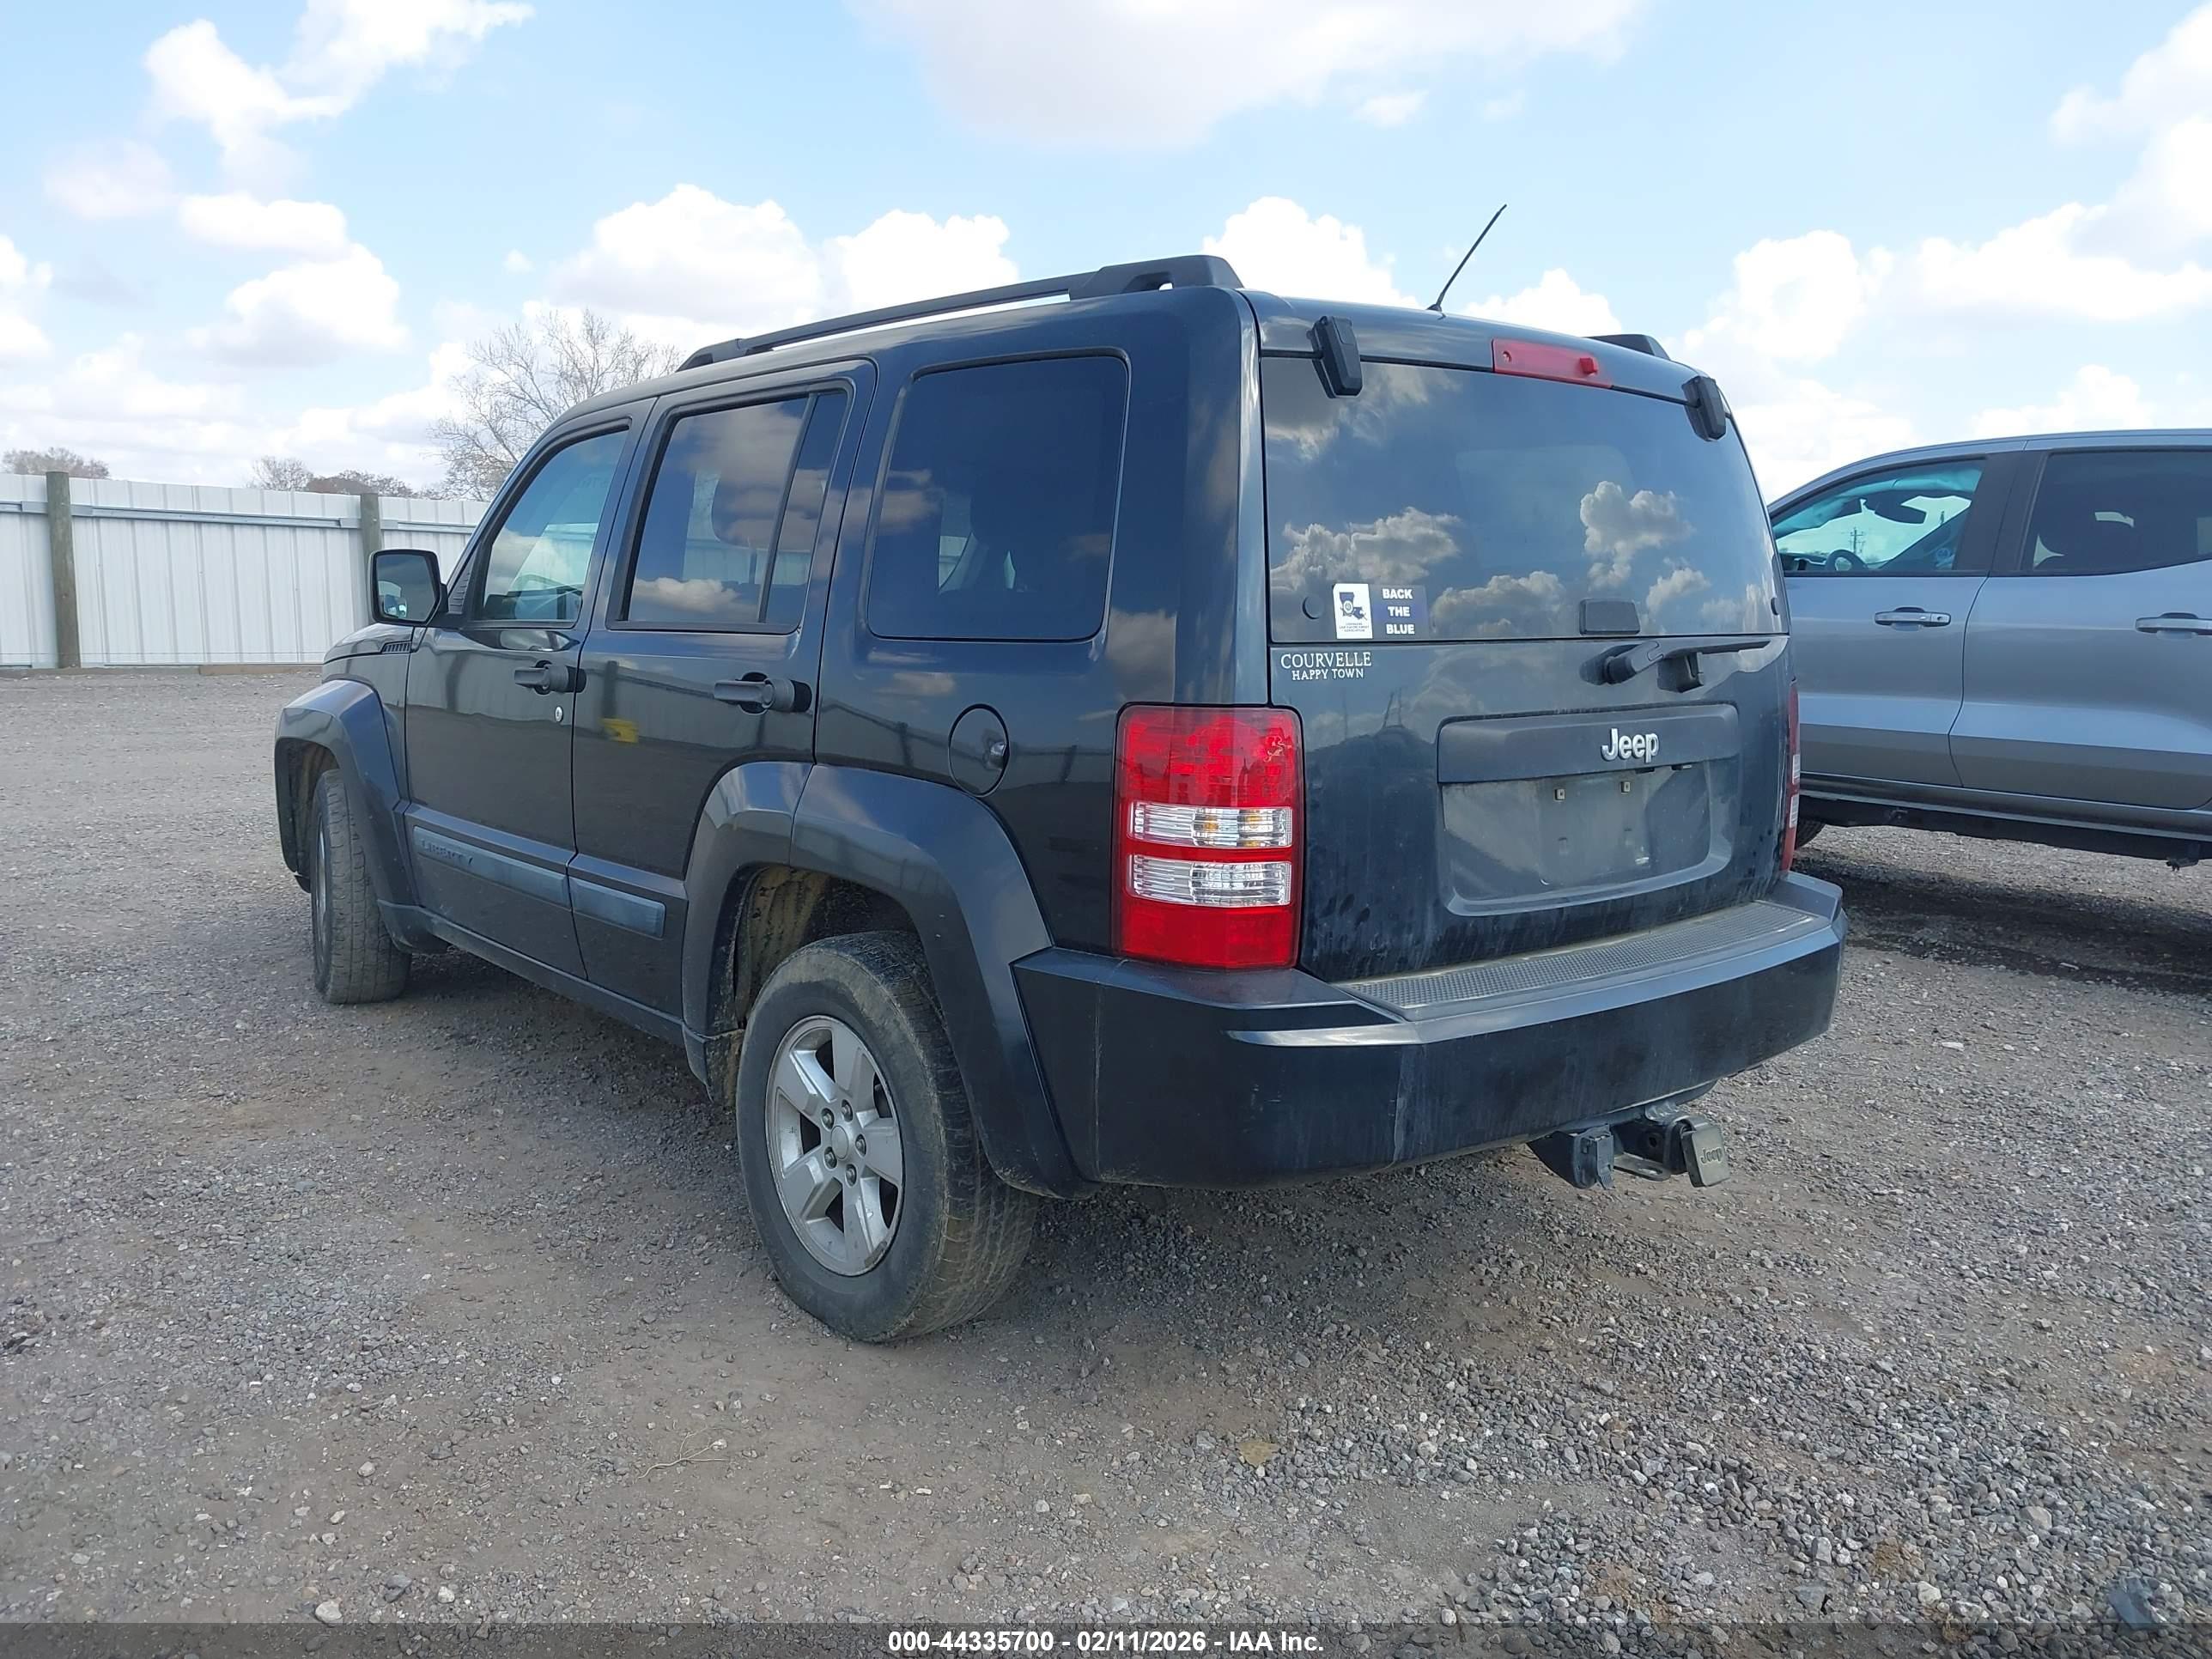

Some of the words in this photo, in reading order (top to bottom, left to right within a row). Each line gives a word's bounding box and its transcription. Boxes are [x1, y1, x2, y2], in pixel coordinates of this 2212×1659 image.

[1382, 588, 1413, 599] BACK
[1387, 606, 1411, 617] THE
[1386, 624, 1415, 635] BLUE
[1280, 652, 1372, 669] COURVELLE
[1291, 669, 1328, 681] HAPPY
[1331, 668, 1364, 679] TOWN
[1601, 727, 1659, 763] Jeep
